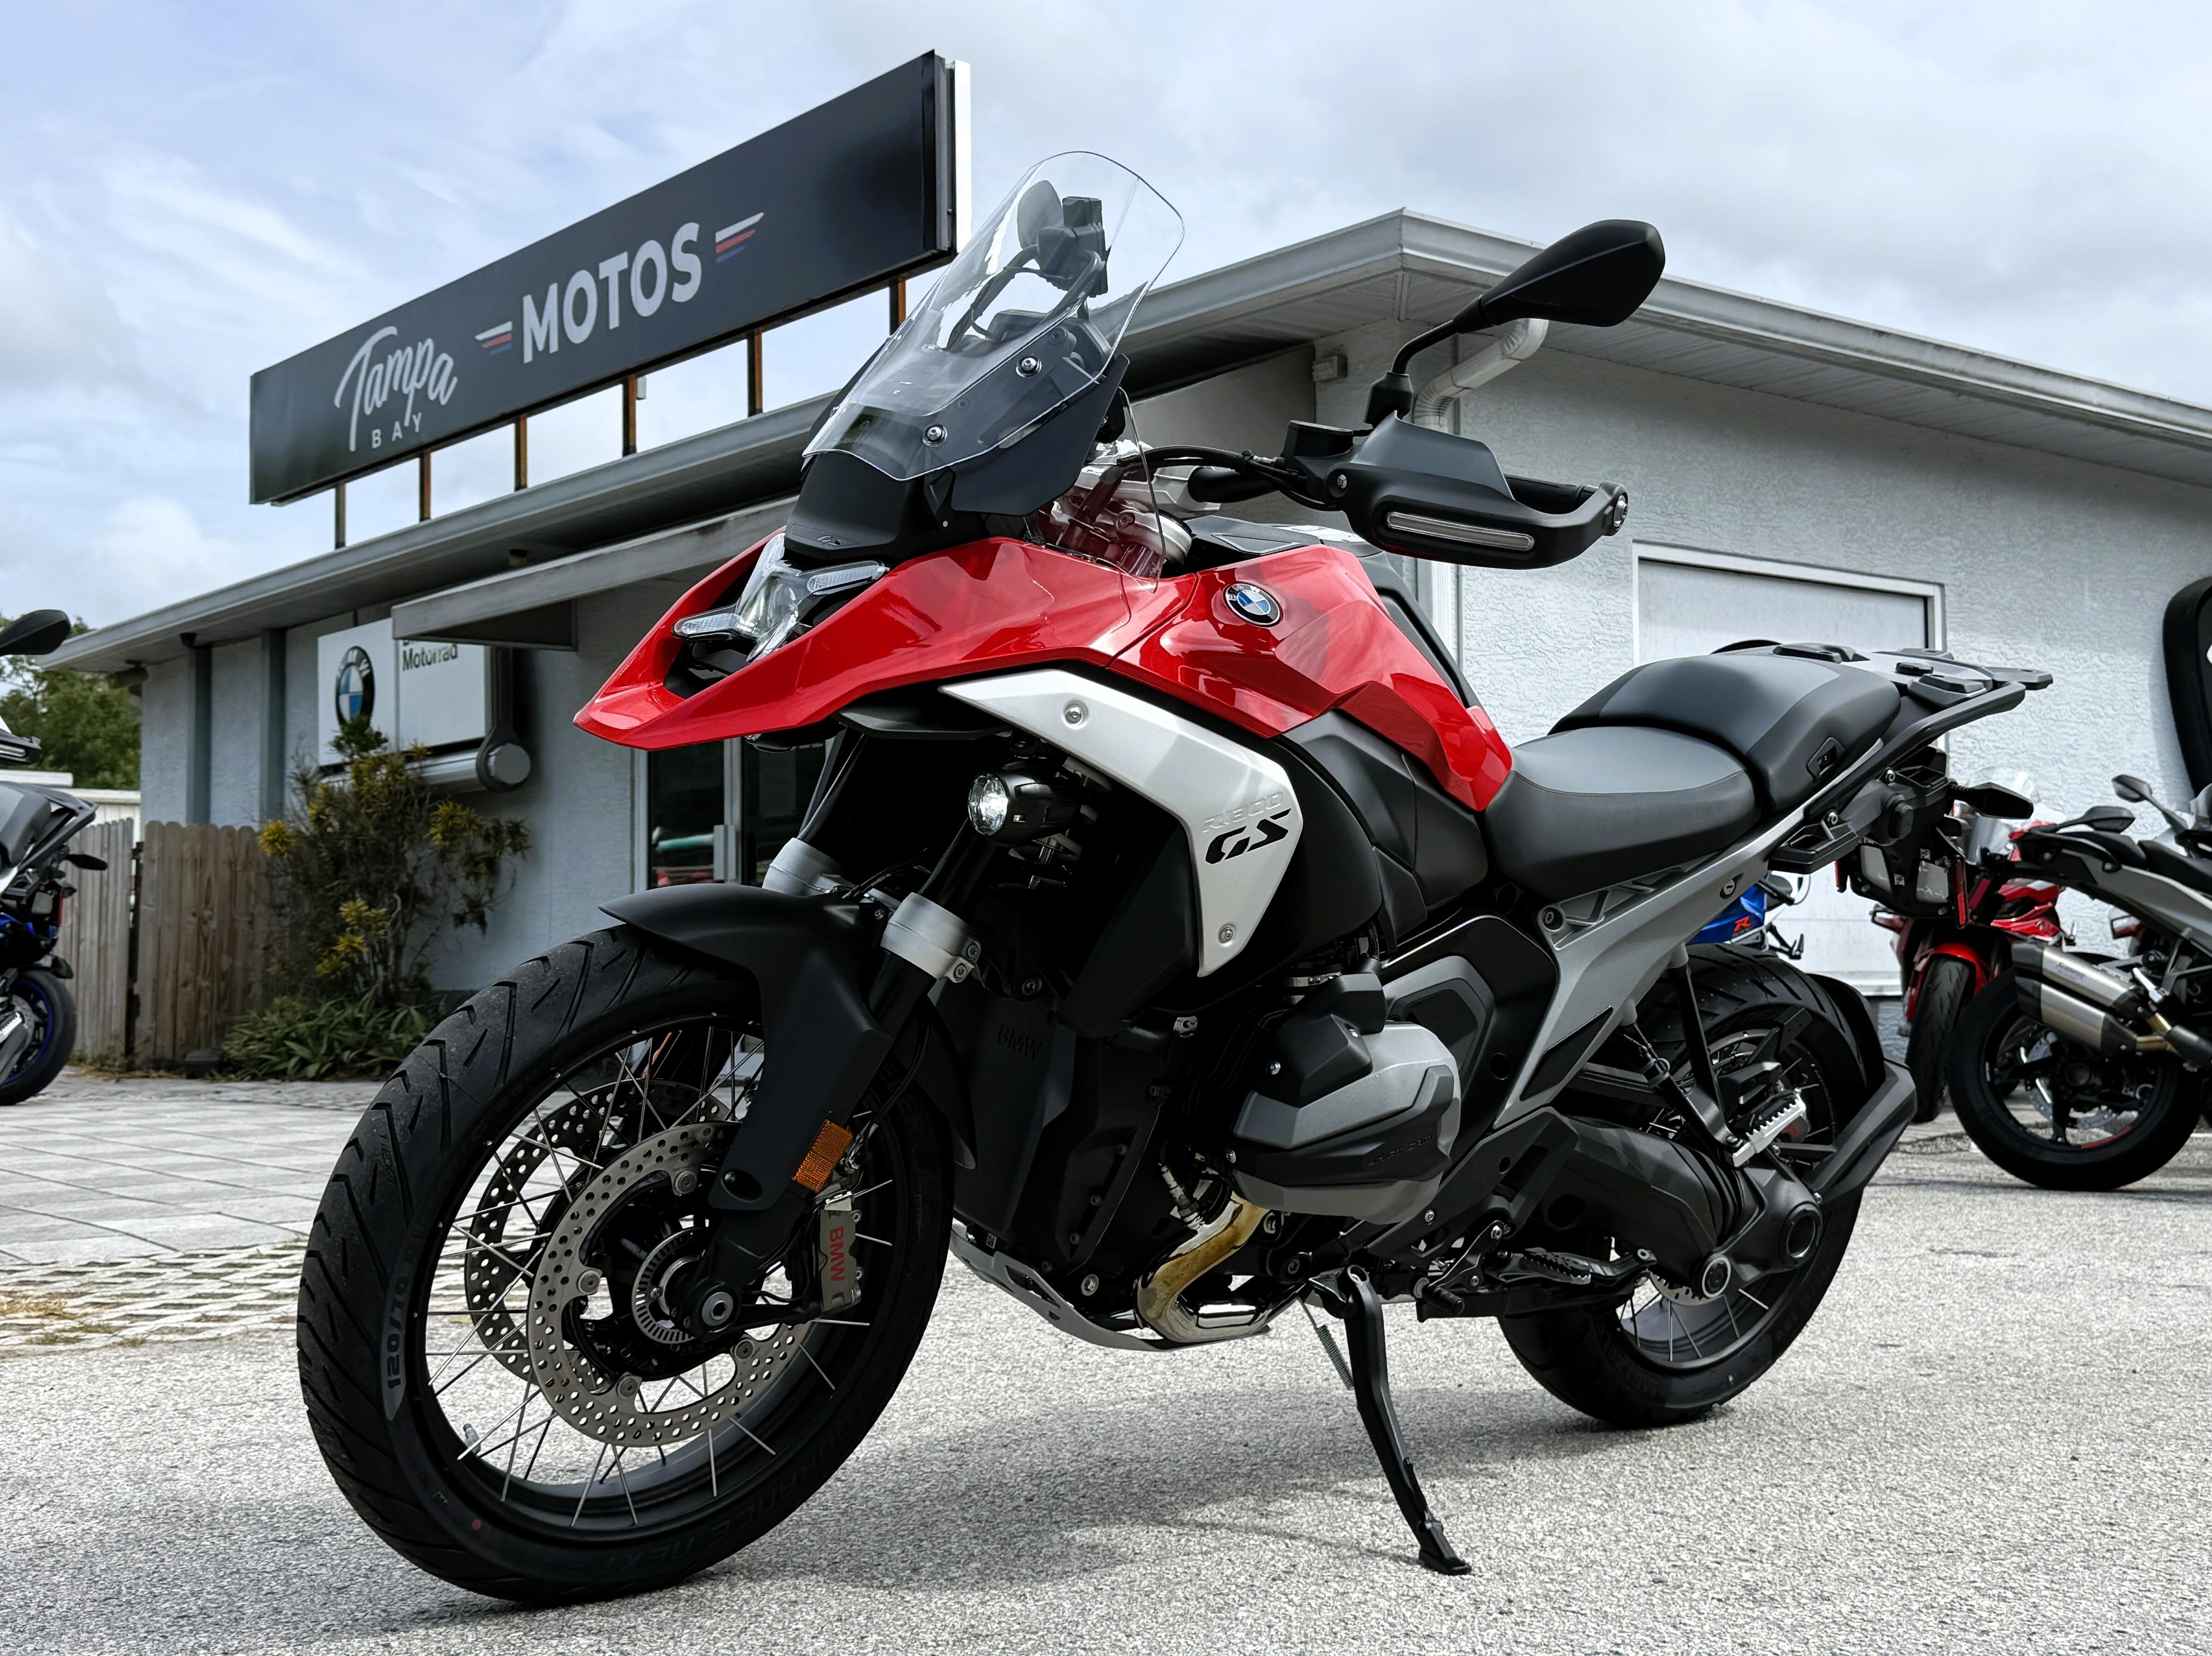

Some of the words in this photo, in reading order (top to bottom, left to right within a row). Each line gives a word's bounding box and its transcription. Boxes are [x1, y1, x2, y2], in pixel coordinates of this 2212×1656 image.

[523, 222, 702, 363] MOTOS
[334, 326, 458, 452] Tampa
[372, 412, 423, 449] BAY
[1228, 585, 1260, 601] BMW
[402, 644, 458, 671] Motorrad
[1205, 808, 1292, 864] GS
[997, 1024, 1043, 1060] BMW
[829, 1227, 845, 1282] BMW
